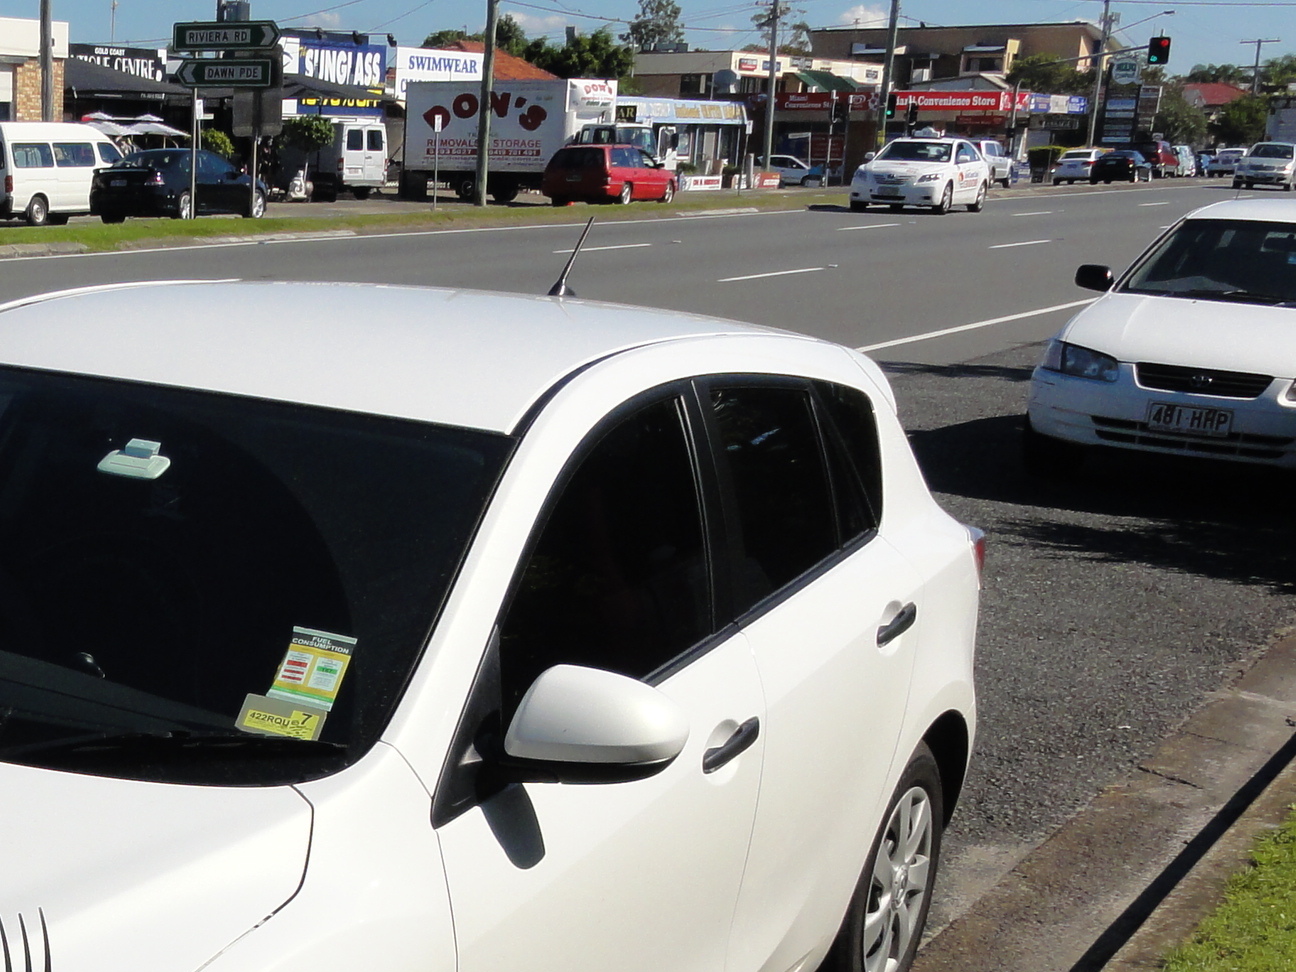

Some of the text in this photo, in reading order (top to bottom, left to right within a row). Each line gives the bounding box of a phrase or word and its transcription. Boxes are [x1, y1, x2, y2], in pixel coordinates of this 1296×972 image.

[188, 31, 248, 42] RIVIERA RD
[109, 48, 126, 56] COAST
[408, 55, 478, 74] SWIMWEAR
[207, 67, 259, 79] DAWN PDE
[918, 95, 971, 106] Convenience
[972, 95, 996, 106] Store
[493, 139, 541, 148] STORAGE
[292, 637, 350, 654] CONSUMPTION
[312, 636, 332, 646] FUEL
[249, 711, 291, 728] 422RQU
[301, 712, 313, 725] 7
